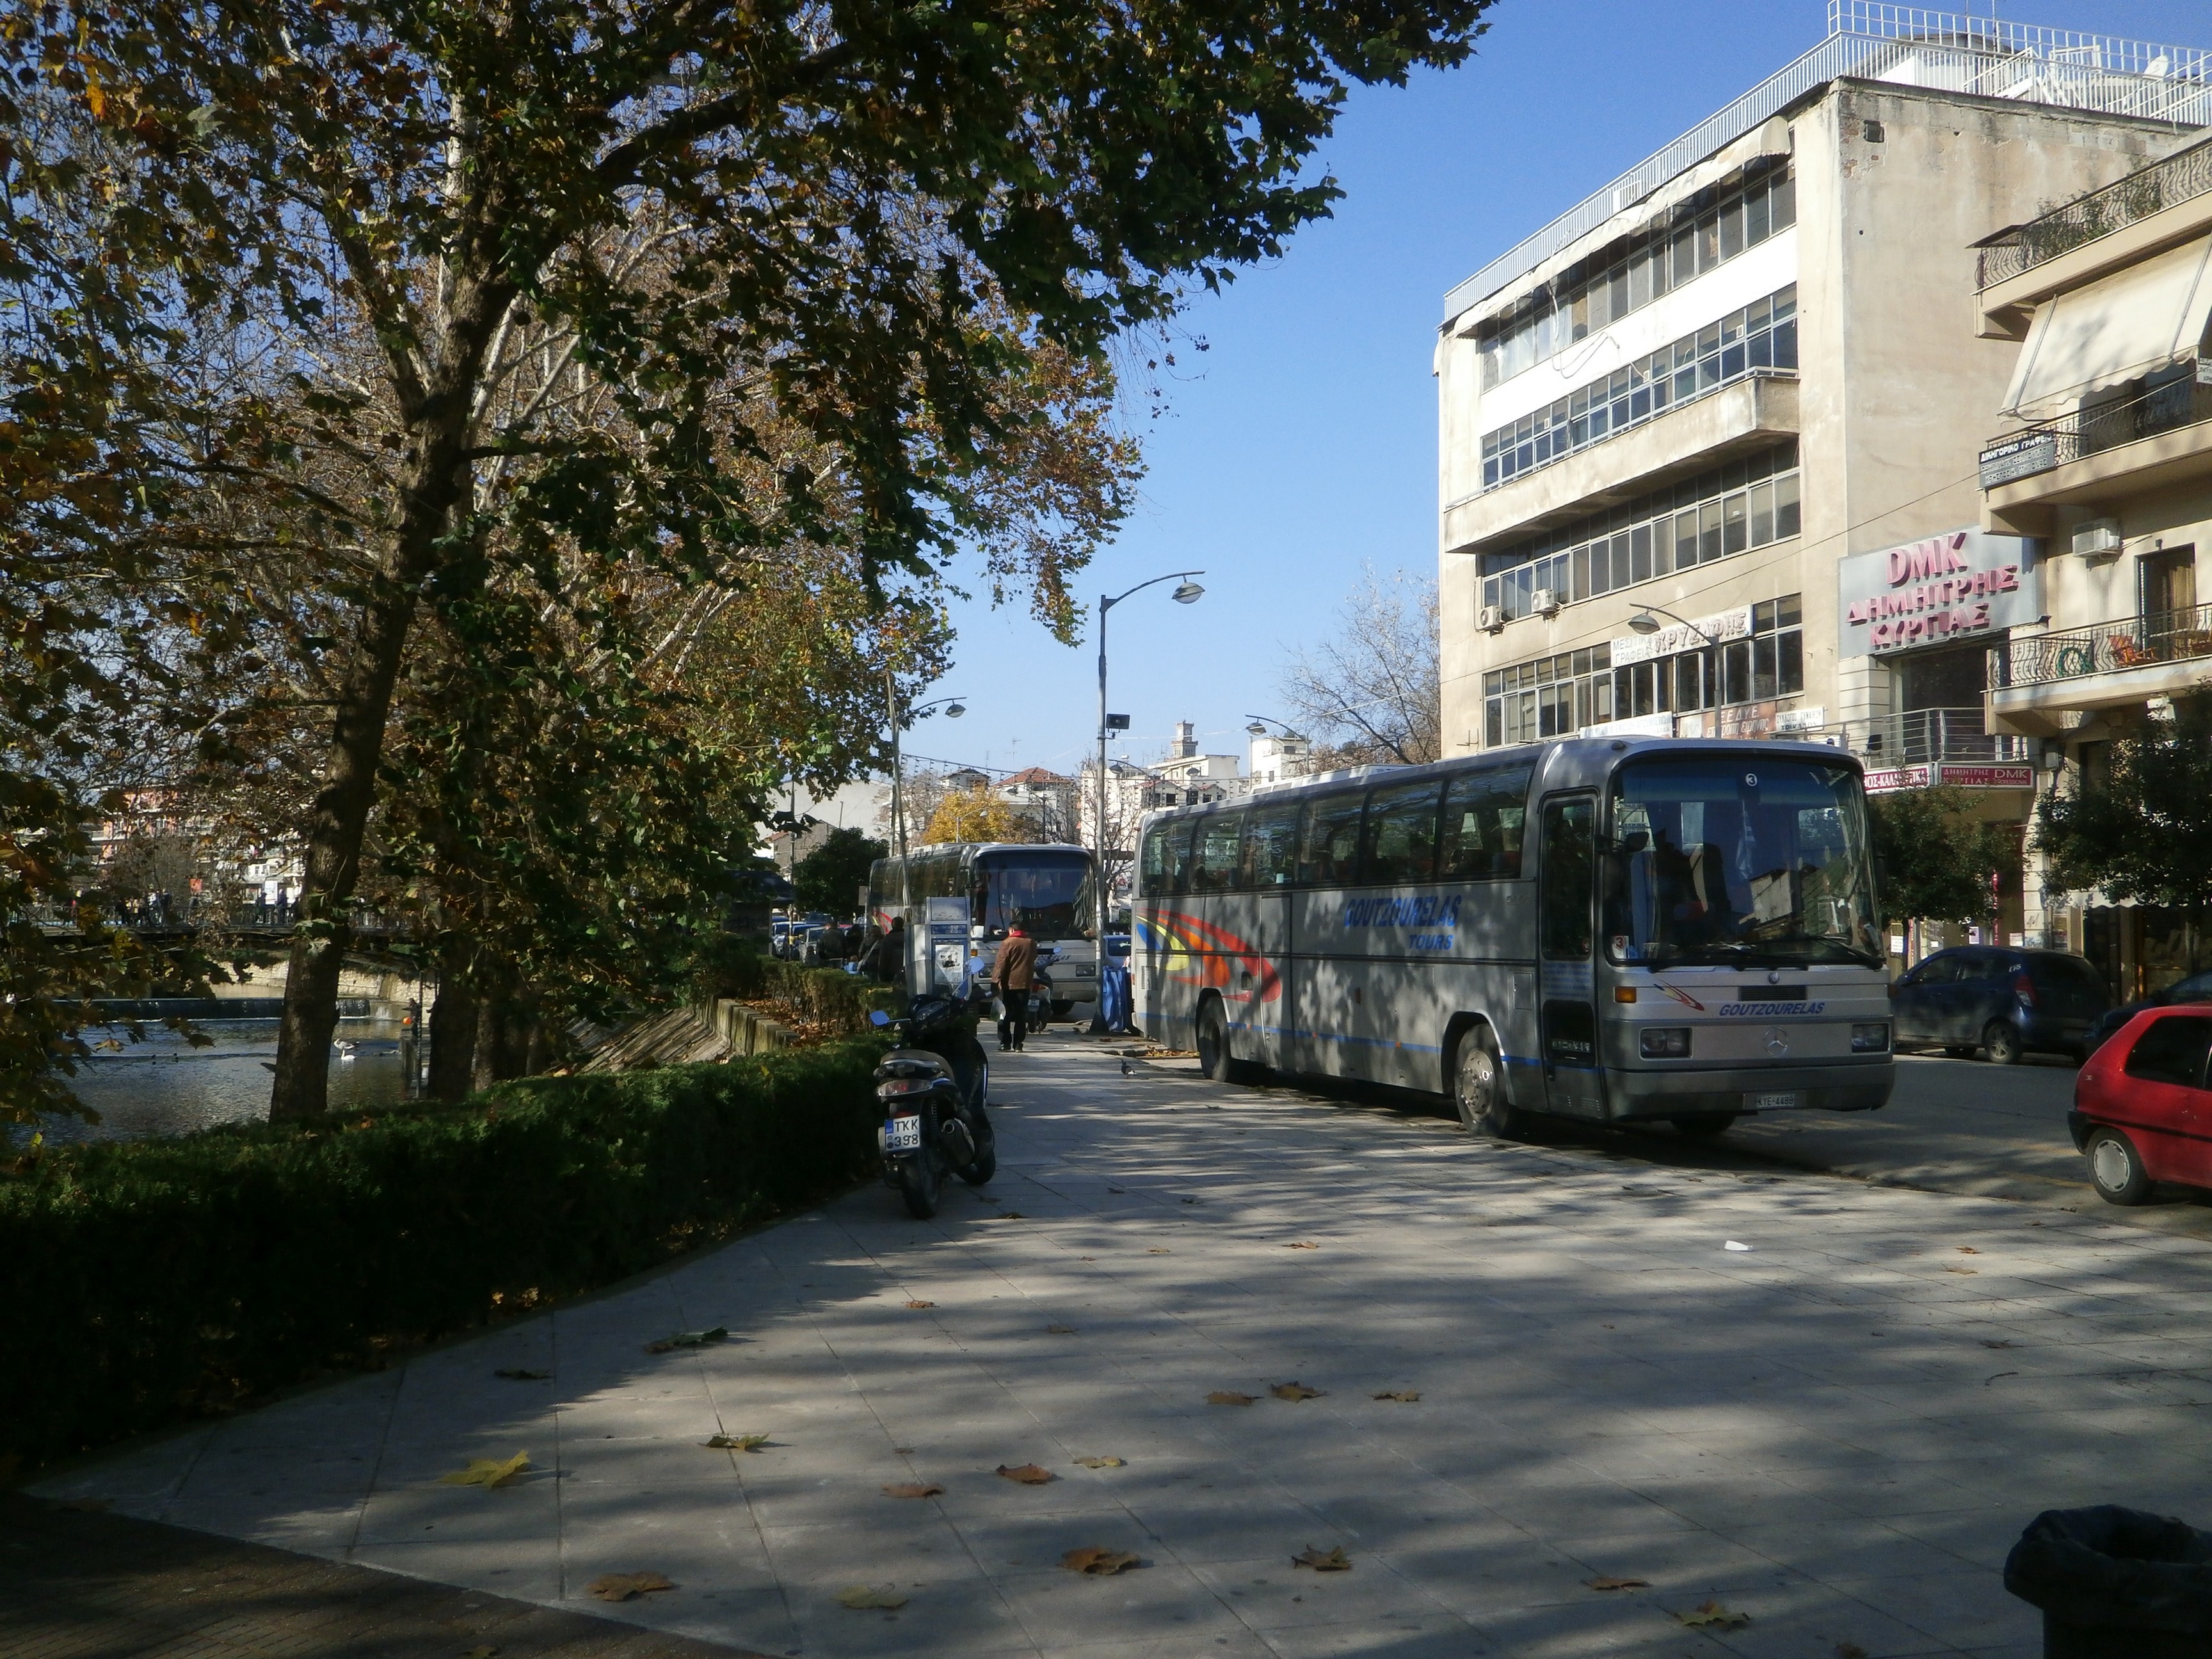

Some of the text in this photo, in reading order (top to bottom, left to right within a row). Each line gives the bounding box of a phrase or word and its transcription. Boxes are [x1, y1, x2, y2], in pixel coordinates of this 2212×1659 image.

[1885, 533, 1968, 588] DMK
[1846, 565, 2019, 626] ΔΗΜΗΤΡΗΣ
[1870, 603, 1991, 649] ΚΥΡΓΙΑΣ
[1994, 769, 2027, 778] DMK
[1345, 895, 1463, 928] GOUTZOURELAS
[1409, 934, 1455, 950] TOURS
[1615, 936, 1624, 949] 3
[1719, 1002, 1825, 1016] GOUTZOURELAS
[895, 1119, 918, 1132] TKK
[894, 1134, 918, 1146] 398
